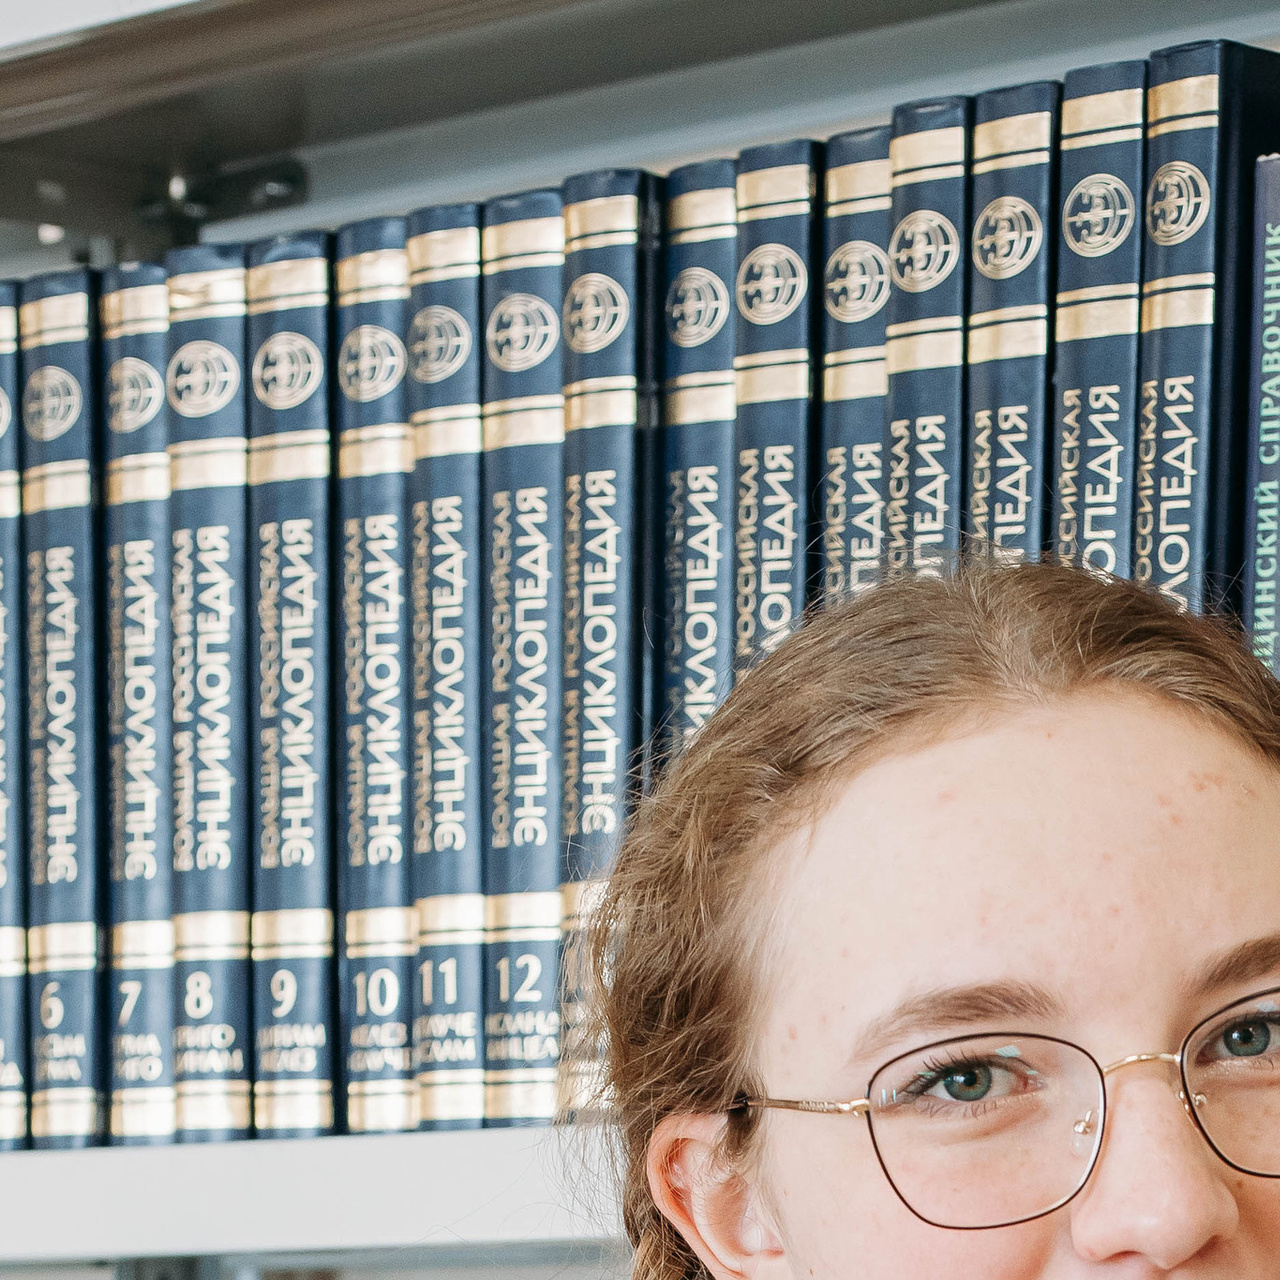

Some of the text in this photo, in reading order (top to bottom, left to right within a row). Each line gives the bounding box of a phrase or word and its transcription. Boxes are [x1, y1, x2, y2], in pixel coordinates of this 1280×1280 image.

[736, 449, 759, 656] РОССИЙСКАЯ
[1083, 385, 1124, 586] ОПЕДИЯ
[1158, 375, 1198, 617] ЛОПЕДИЯ
[46, 546, 79, 883] ЭНЦИКЛОПЕДИЯ
[125, 539, 160, 880] ЭНЦИКЛОПЕДИЯ
[196, 524, 235, 871] ЭНЦИКЛОПЕДИЯ
[281, 518, 319, 868] ЭНЦИКЛОПЕДИЯ
[365, 513, 405, 866] ЭНЦИКЛОПЕДИЯ
[432, 496, 470, 852] ЭНЦИКЛОПЕДИЯ
[513, 486, 552, 847] ЭНЦИКЛОПЕДИЯ
[582, 469, 622, 835] ЭНЦИКЛОПЕДИЯ
[39, 980, 64, 1029] 6
[118, 979, 142, 1026] 7
[184, 970, 213, 1019] 8
[270, 968, 297, 1018] 9
[353, 967, 399, 1016] 10
[418, 956, 458, 1005] 11
[496, 952, 543, 1002] 12
